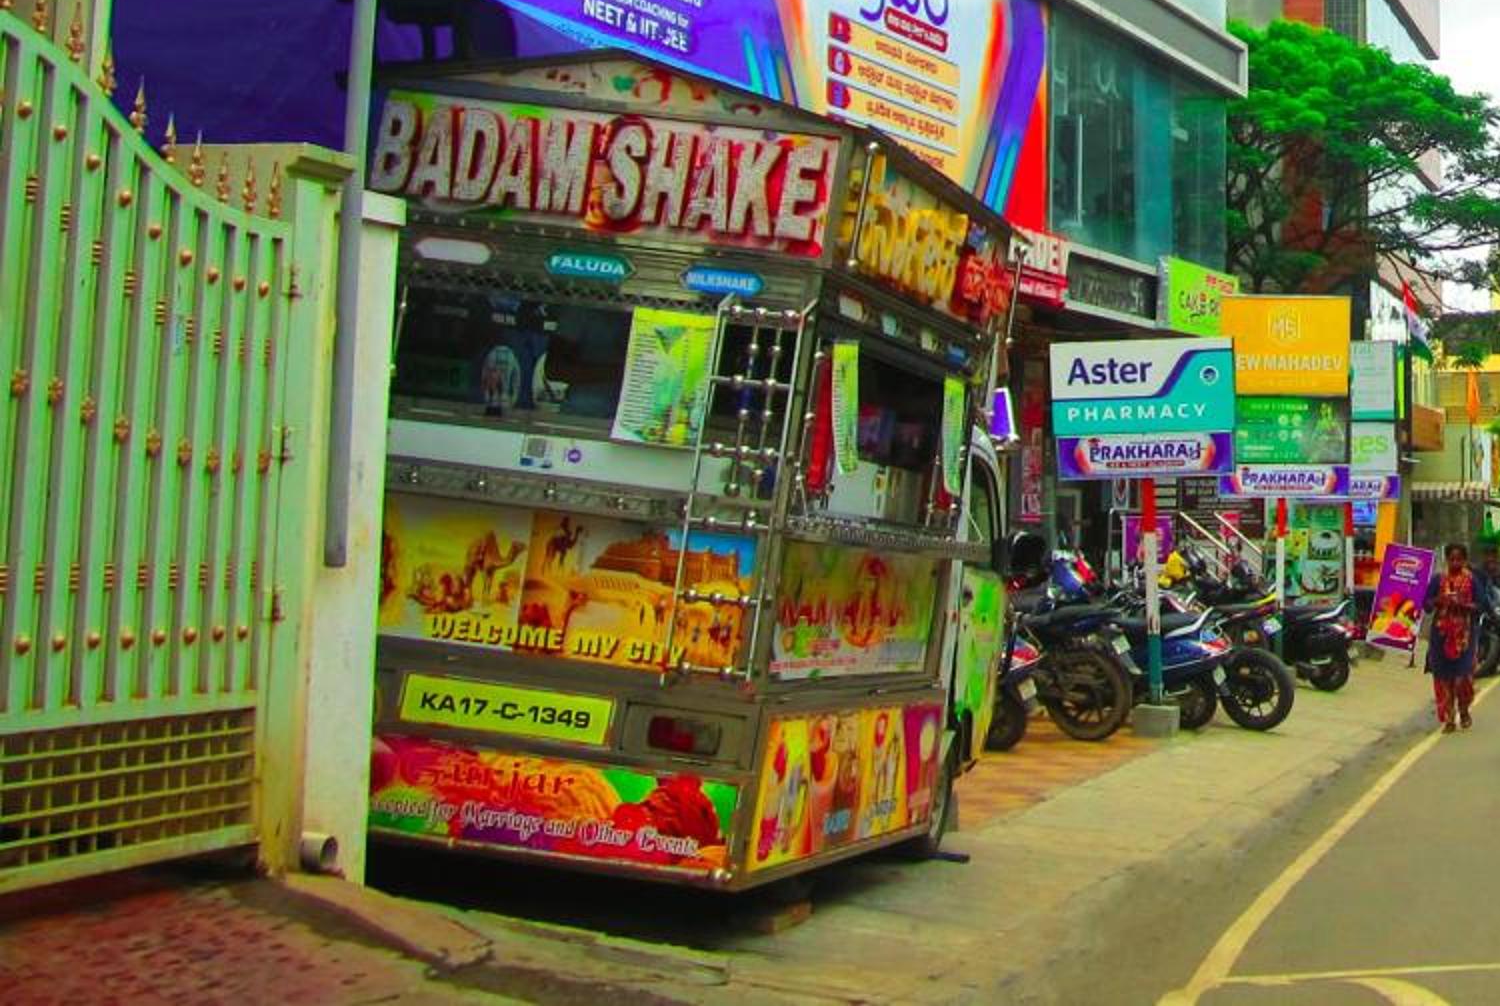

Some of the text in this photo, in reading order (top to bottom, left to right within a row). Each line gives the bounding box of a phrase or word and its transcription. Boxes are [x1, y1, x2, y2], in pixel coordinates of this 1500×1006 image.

[625, 12, 638, 34] &
[368, 98, 836, 241] BADAM SHAKE
[551, 256, 625, 275] FALUDA
[1068, 357, 1152, 386] Aster
[1235, 354, 1342, 371] EW MAHADEV
[1067, 403, 1207, 422] PHARMACY
[431, 614, 564, 650] WELCOME
[543, 817, 577, 839] and
[578, 817, 634, 846] Other
